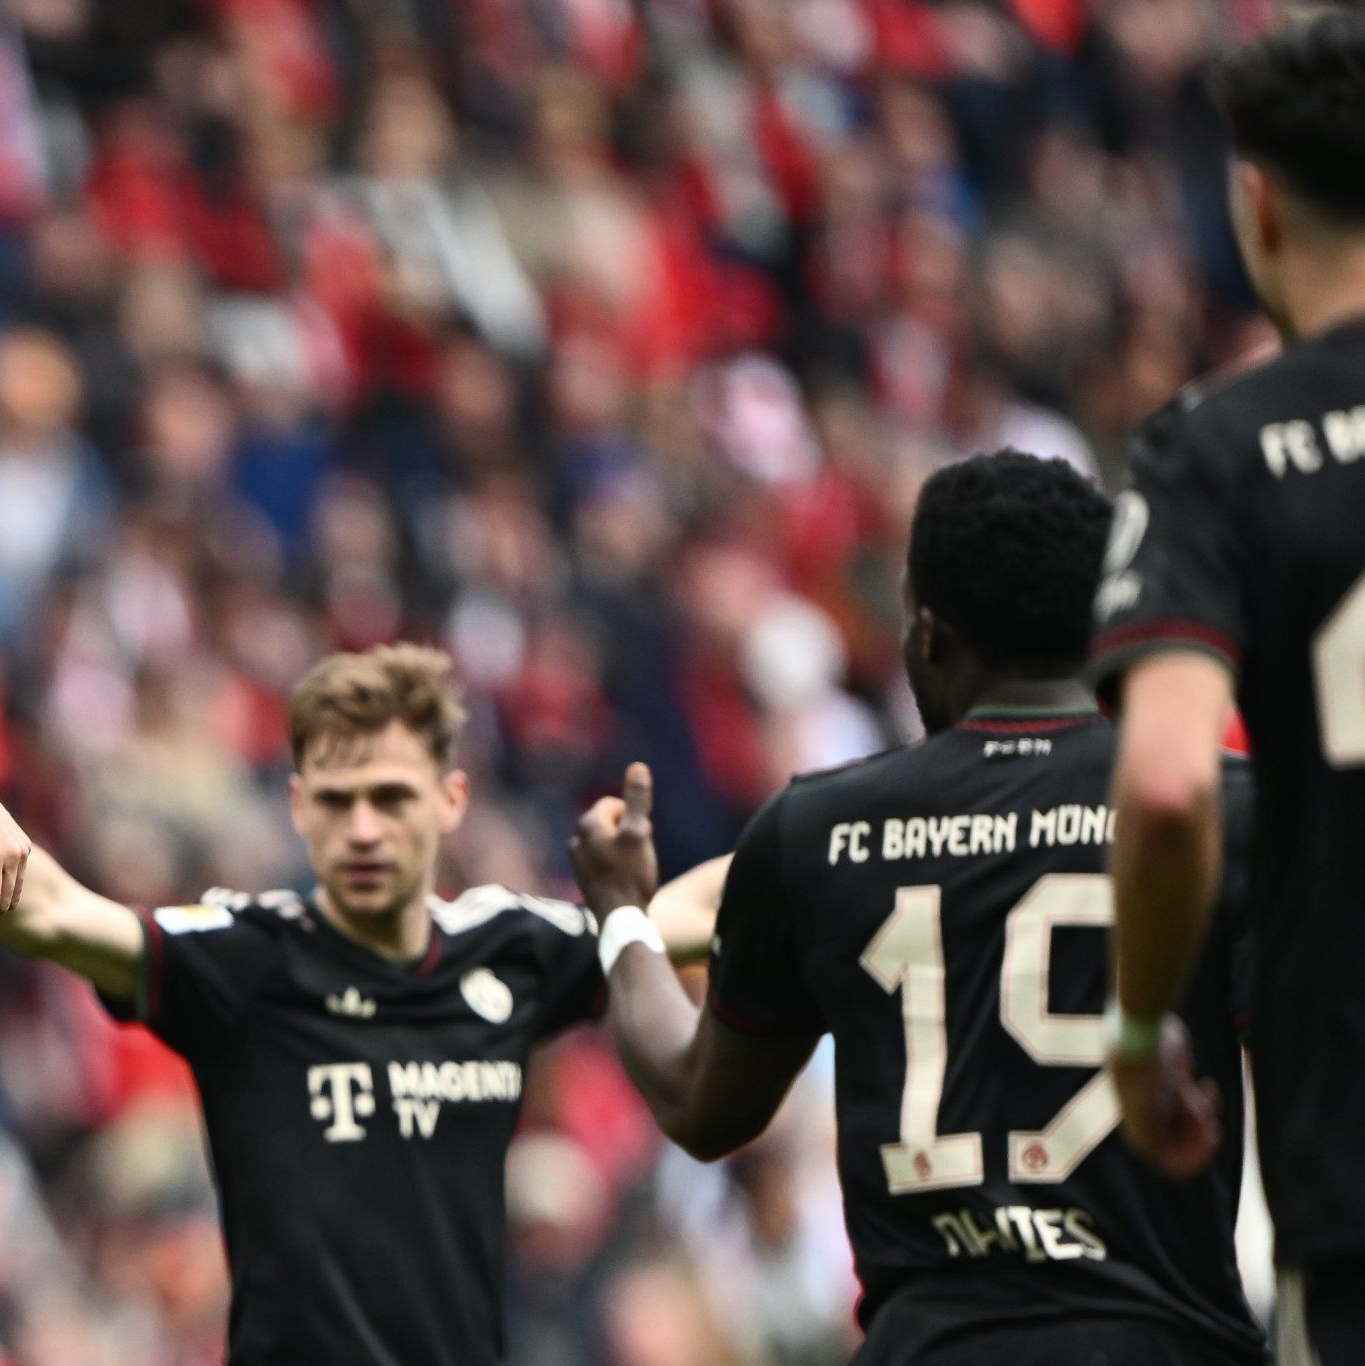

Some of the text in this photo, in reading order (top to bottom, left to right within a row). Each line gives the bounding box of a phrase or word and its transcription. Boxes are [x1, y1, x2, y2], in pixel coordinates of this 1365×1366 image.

[828, 821, 871, 866] FC
[882, 811, 1018, 860] BAYERN
[859, 872, 1121, 1195] 19
[392, 1101, 442, 1140] TV
